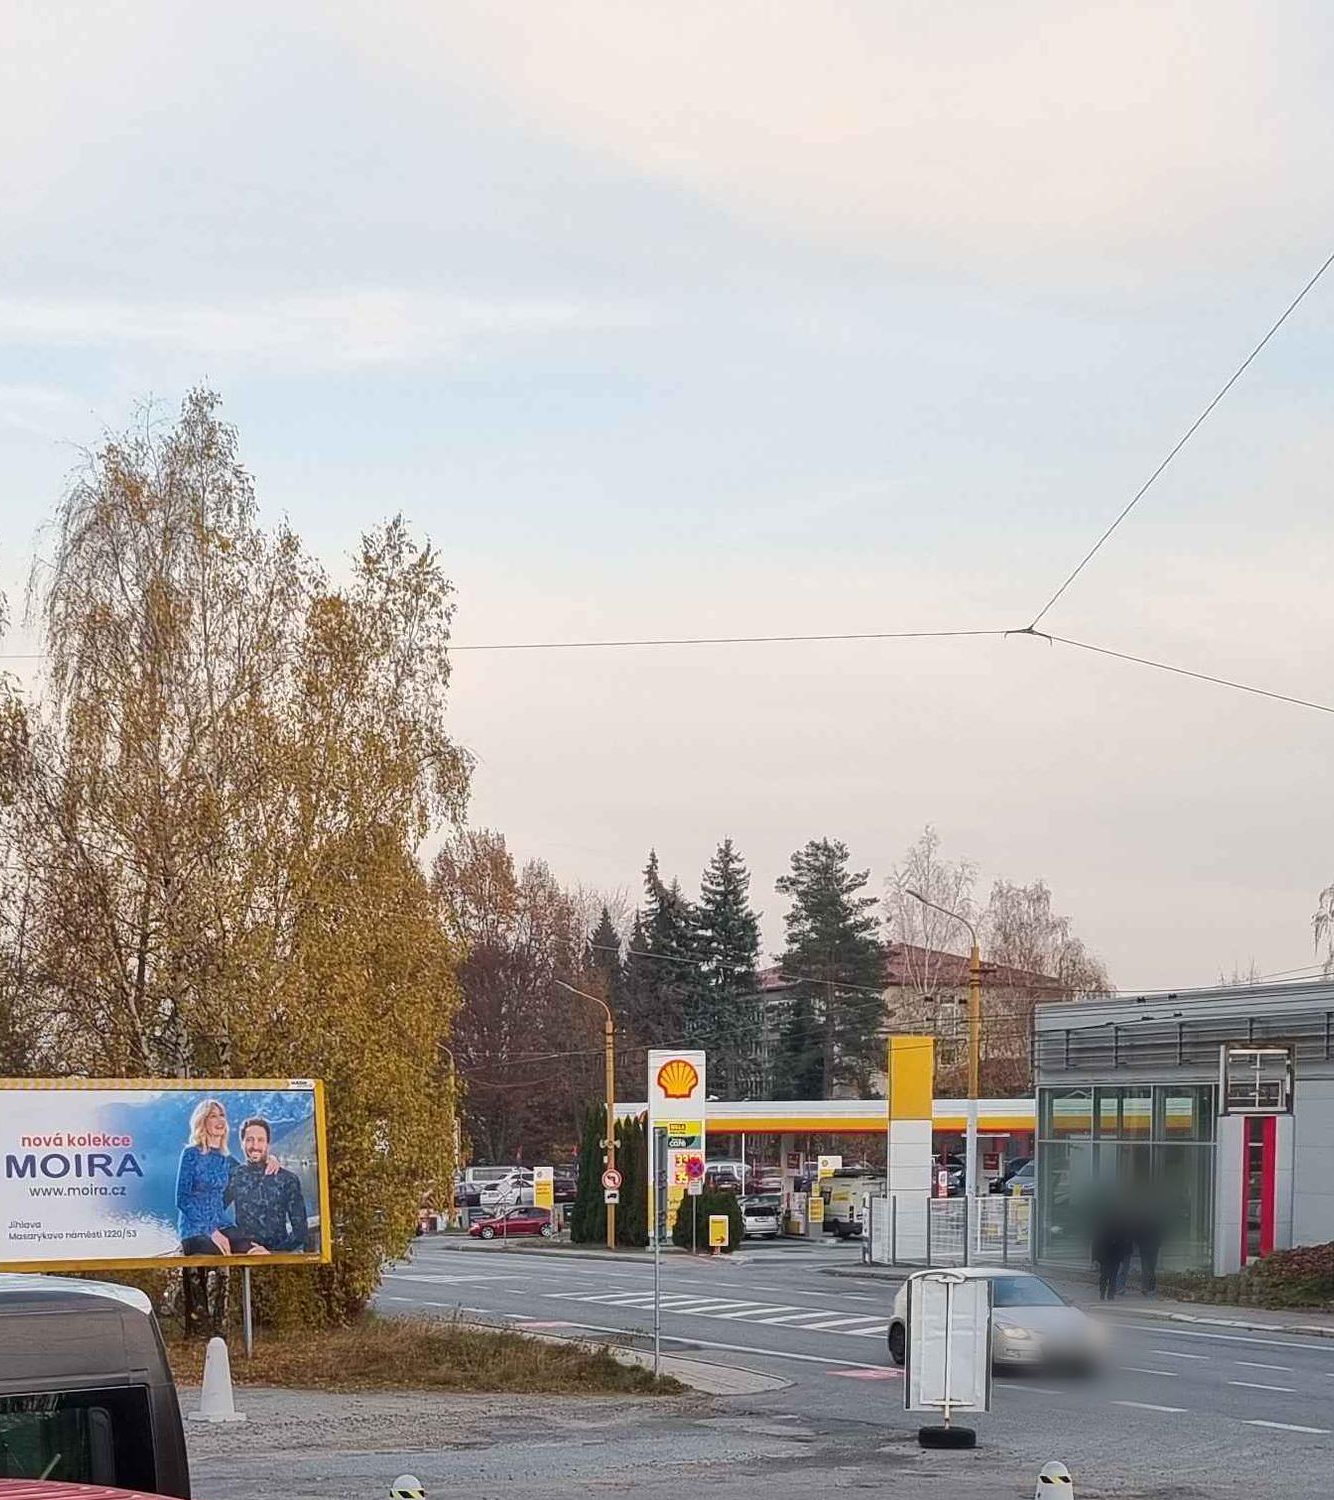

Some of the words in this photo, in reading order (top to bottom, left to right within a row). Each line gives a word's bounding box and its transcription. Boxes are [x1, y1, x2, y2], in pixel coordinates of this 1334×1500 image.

[21, 1133, 63, 1147] nová
[67, 1133, 131, 1147] kolekce
[6, 1153, 144, 1178] MOIRA
[29, 1184, 127, 1197] www.moira.cz
[8, 1221, 41, 1229] Jihlava
